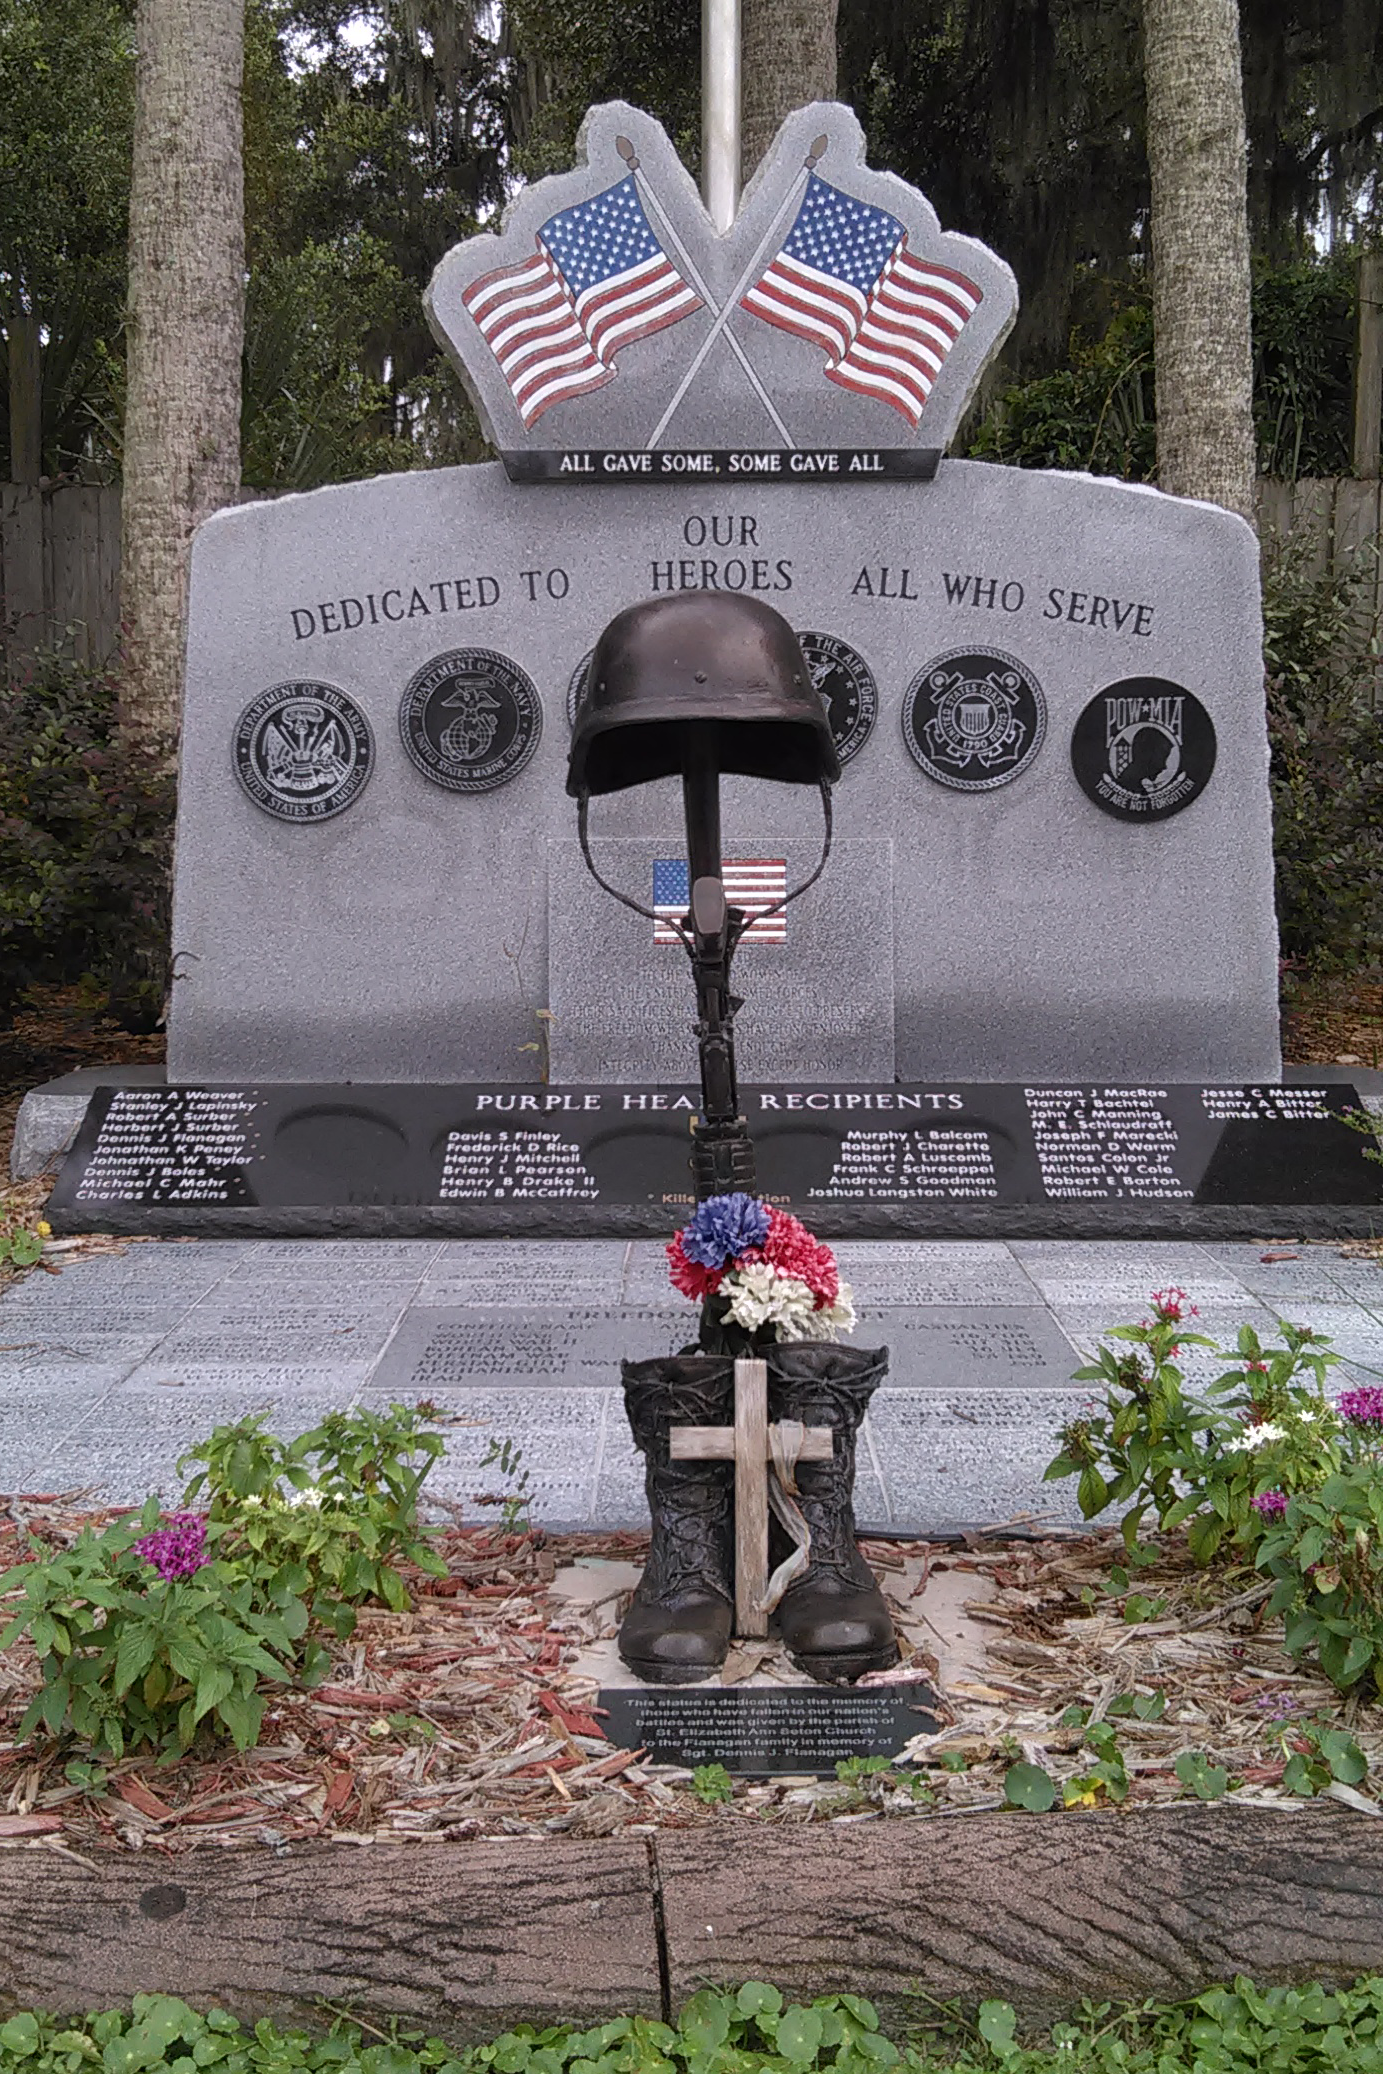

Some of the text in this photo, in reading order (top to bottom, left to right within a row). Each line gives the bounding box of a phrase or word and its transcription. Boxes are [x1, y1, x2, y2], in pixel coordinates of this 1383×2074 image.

[560, 455, 594, 472] ALL
[603, 455, 652, 472] GAVE
[729, 455, 780, 472] SOME
[790, 455, 840, 472] GAVE
[849, 455, 884, 472] ALL
[684, 516, 759, 547] OUR
[651, 560, 793, 591] HEROES
[291, 568, 569, 640] DEDICATED TO
[852, 566, 1153, 636] ALL WHO SERVE
[815, 636, 874, 721] THE AIR FORCE
[410, 659, 532, 717] DEPARTMENT OF THE NAVY
[949, 684, 977, 706] STATES
[980, 685, 1006, 710] COAST
[241, 685, 367, 740] DEPARTMENT OF THE ARMY
[1104, 697, 1185, 748] POW MIA
[963, 740, 988, 748] 1790
[414, 732, 527, 778] UNITED STATES MARINE CORPS
[241, 762, 365, 815] UNITED STATES OF AMERICA
[1095, 779, 1195, 811] YOU ARE NOT FORGOTTEN
[1024, 1089, 1167, 1097] Duncan J MacRae
[174, 1102, 182, 1110] J
[475, 1094, 964, 1110] PURPLE HEA RECIPIENTS
[1026, 1100, 1071, 1109] Harry
[106, 1113, 237, 1121] Robert A Surber
[1030, 1110, 1067, 1118] John
[1074, 1110, 1084, 1118] C
[1208, 1110, 1330, 1118] James C Bitter
[171, 1123, 179, 1132] J
[186, 1123, 239, 1132] Surber
[97, 1134, 151, 1142] Dennis
[158, 1134, 167, 1142] J
[448, 1132, 561, 1142] Davis S Finley
[848, 1131, 987, 1141] Murphy L Balcom
[1034, 1131, 1091, 1141] Joseph
[1098, 1131, 1106, 1140] F
[528, 1143, 539, 1152] D
[546, 1143, 579, 1152] Rice
[1035, 1143, 1175, 1151] Norman D Warm
[183, 1156, 199, 1165] W
[206, 1156, 253, 1166] Taylor
[445, 1155, 494, 1164] Henry
[842, 1153, 896, 1162] Robert
[903, 1153, 914, 1162] A
[1038, 1153, 1169, 1162] Santos Colon Jr
[443, 1166, 489, 1174] Brian
[499, 1166, 506, 1174] L
[1113, 1165, 1129, 1174] W
[1137, 1165, 1173, 1174] Cole
[160, 1179, 170, 1187] C
[179, 1179, 227, 1187] Mahr
[441, 1177, 594, 1187] Henry B Drake II
[830, 1176, 892, 1185] Andrew
[899, 1176, 909, 1185] S
[1043, 1177, 1181, 1185] Robert E Barton
[153, 1191, 161, 1199] L
[169, 1191, 228, 1199] Adkins
[439, 1189, 487, 1197] Edwin
[495, 1189, 505, 1197] B
[807, 1188, 864, 1197] Joshua
[948, 1188, 998, 1197] White
[1115, 1188, 1123, 1197] J
[1130, 1188, 1194, 1197] Hudson
[662, 1194, 695, 1204] Kille
